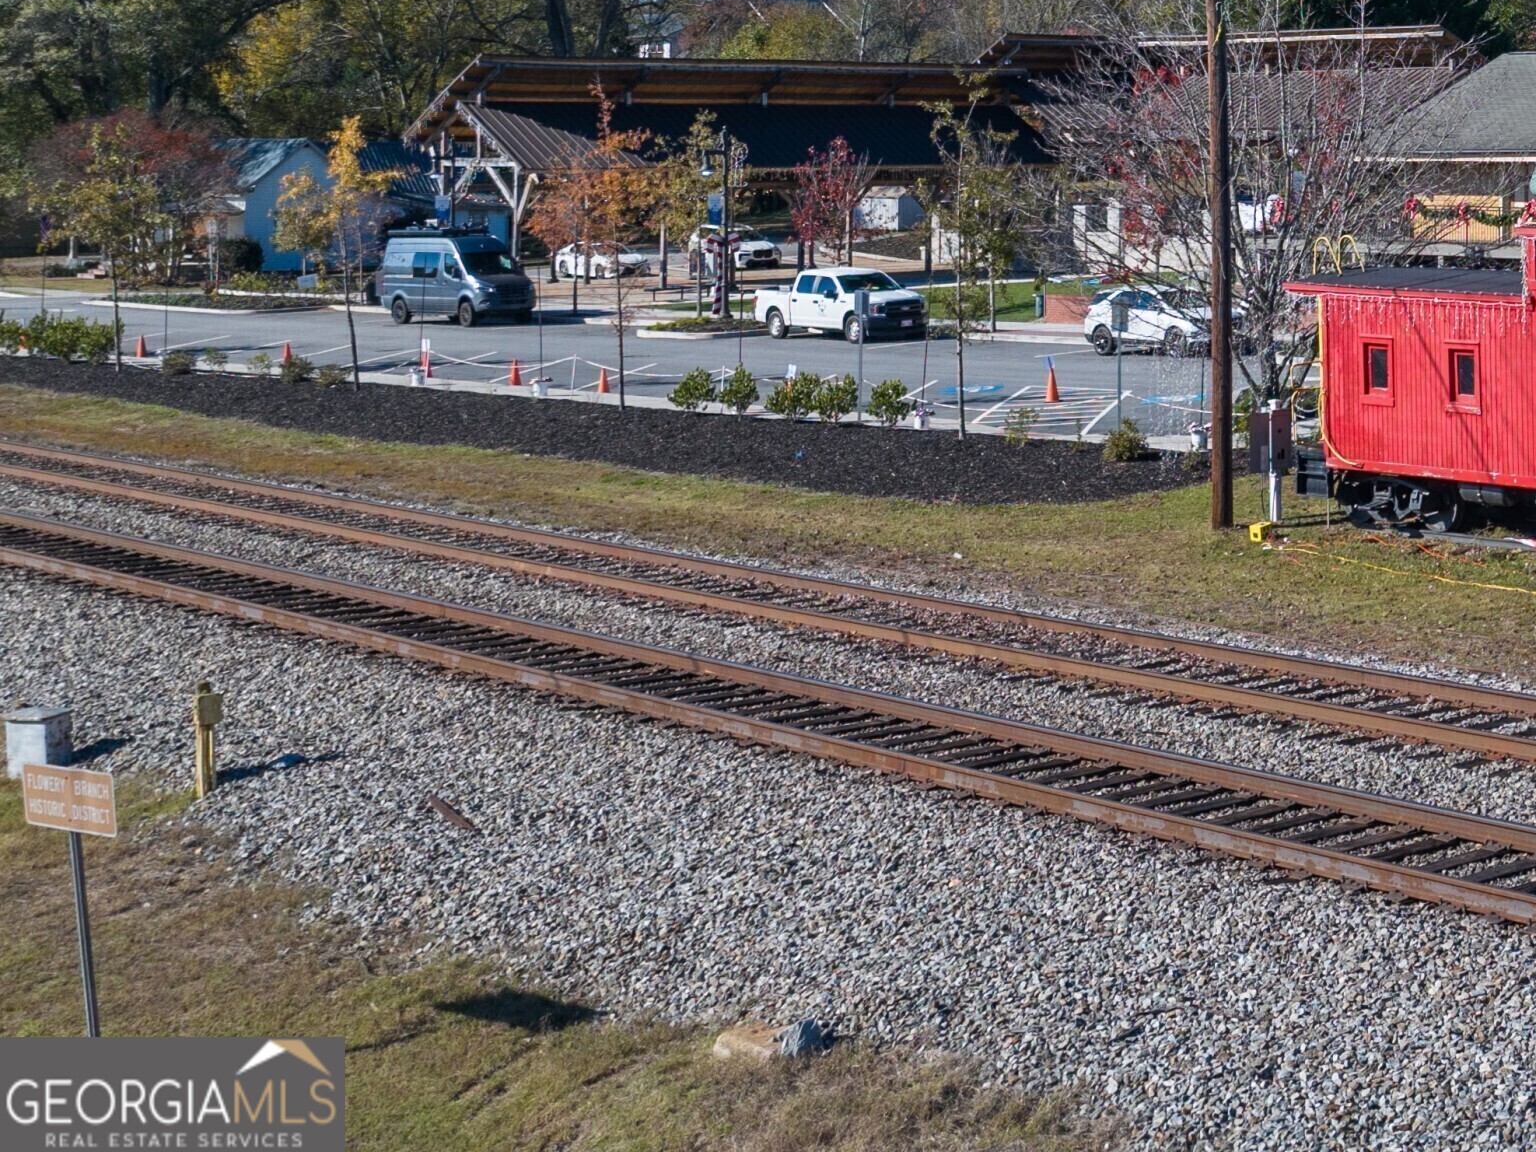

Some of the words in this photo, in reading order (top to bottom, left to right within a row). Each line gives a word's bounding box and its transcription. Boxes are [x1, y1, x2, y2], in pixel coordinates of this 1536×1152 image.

[27, 773, 66, 794] FLOWERY
[74, 780, 109, 800] BRANCH
[29, 798, 67, 818] HISTORIC
[72, 804, 110, 825] DISTRICT
